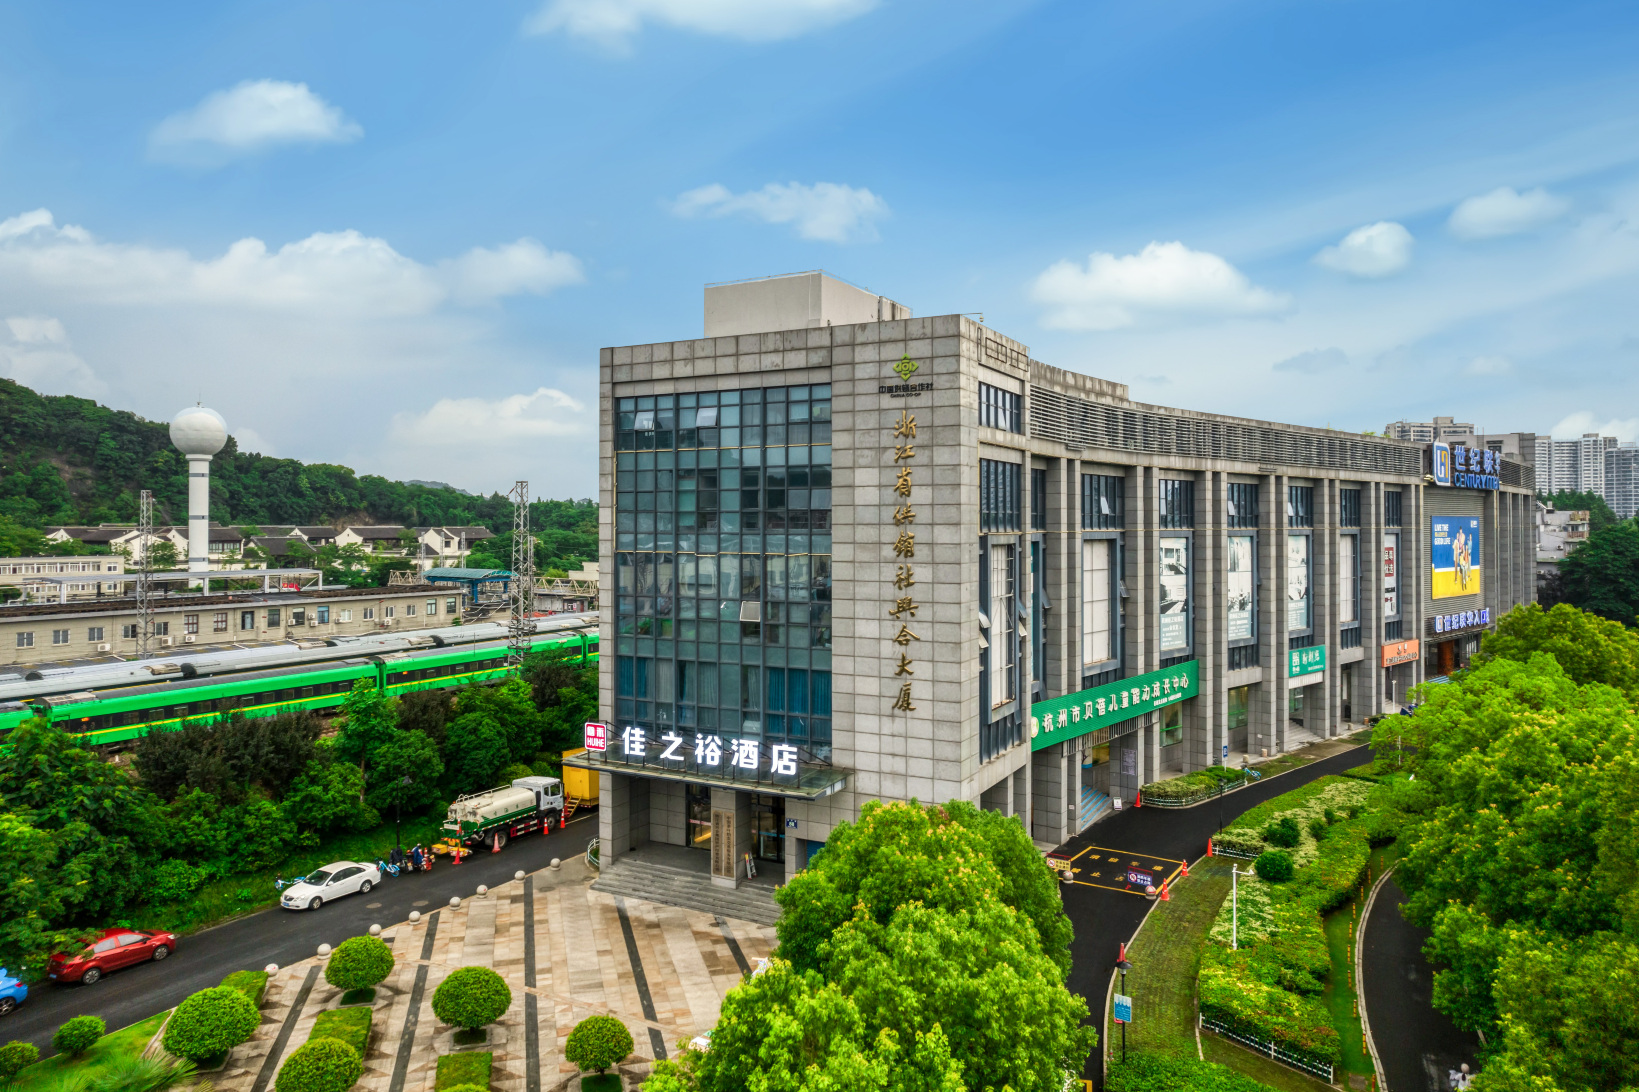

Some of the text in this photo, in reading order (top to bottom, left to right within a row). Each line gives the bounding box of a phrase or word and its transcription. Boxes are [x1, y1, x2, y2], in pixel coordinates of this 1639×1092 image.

[587, 737, 605, 748] HUIHE
[622, 726, 798, 775] 佳之裕酒店
